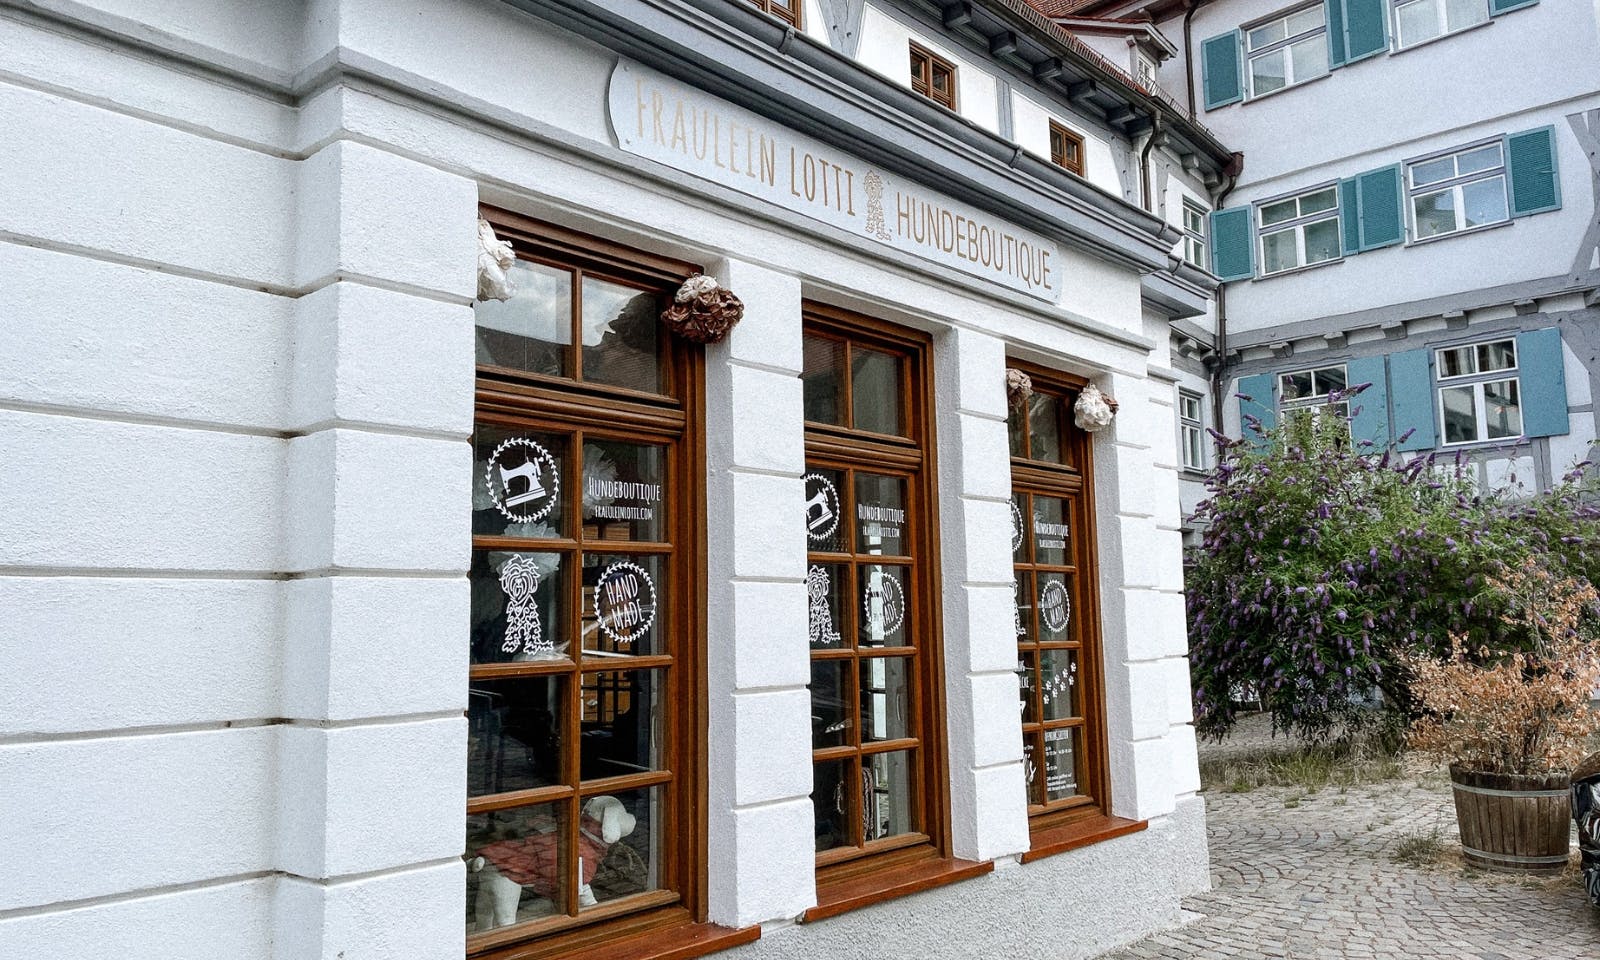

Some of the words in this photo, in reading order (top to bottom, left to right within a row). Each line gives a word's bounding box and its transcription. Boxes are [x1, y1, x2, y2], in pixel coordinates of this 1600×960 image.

[790, 146, 856, 217] LOTTI
[896, 191, 1052, 290] HUNDEBOUTIQUE
[588, 476, 661, 505] HUNDEBOUTIQUE
[605, 573, 638, 605] HAND
[611, 598, 646, 631] MADE
